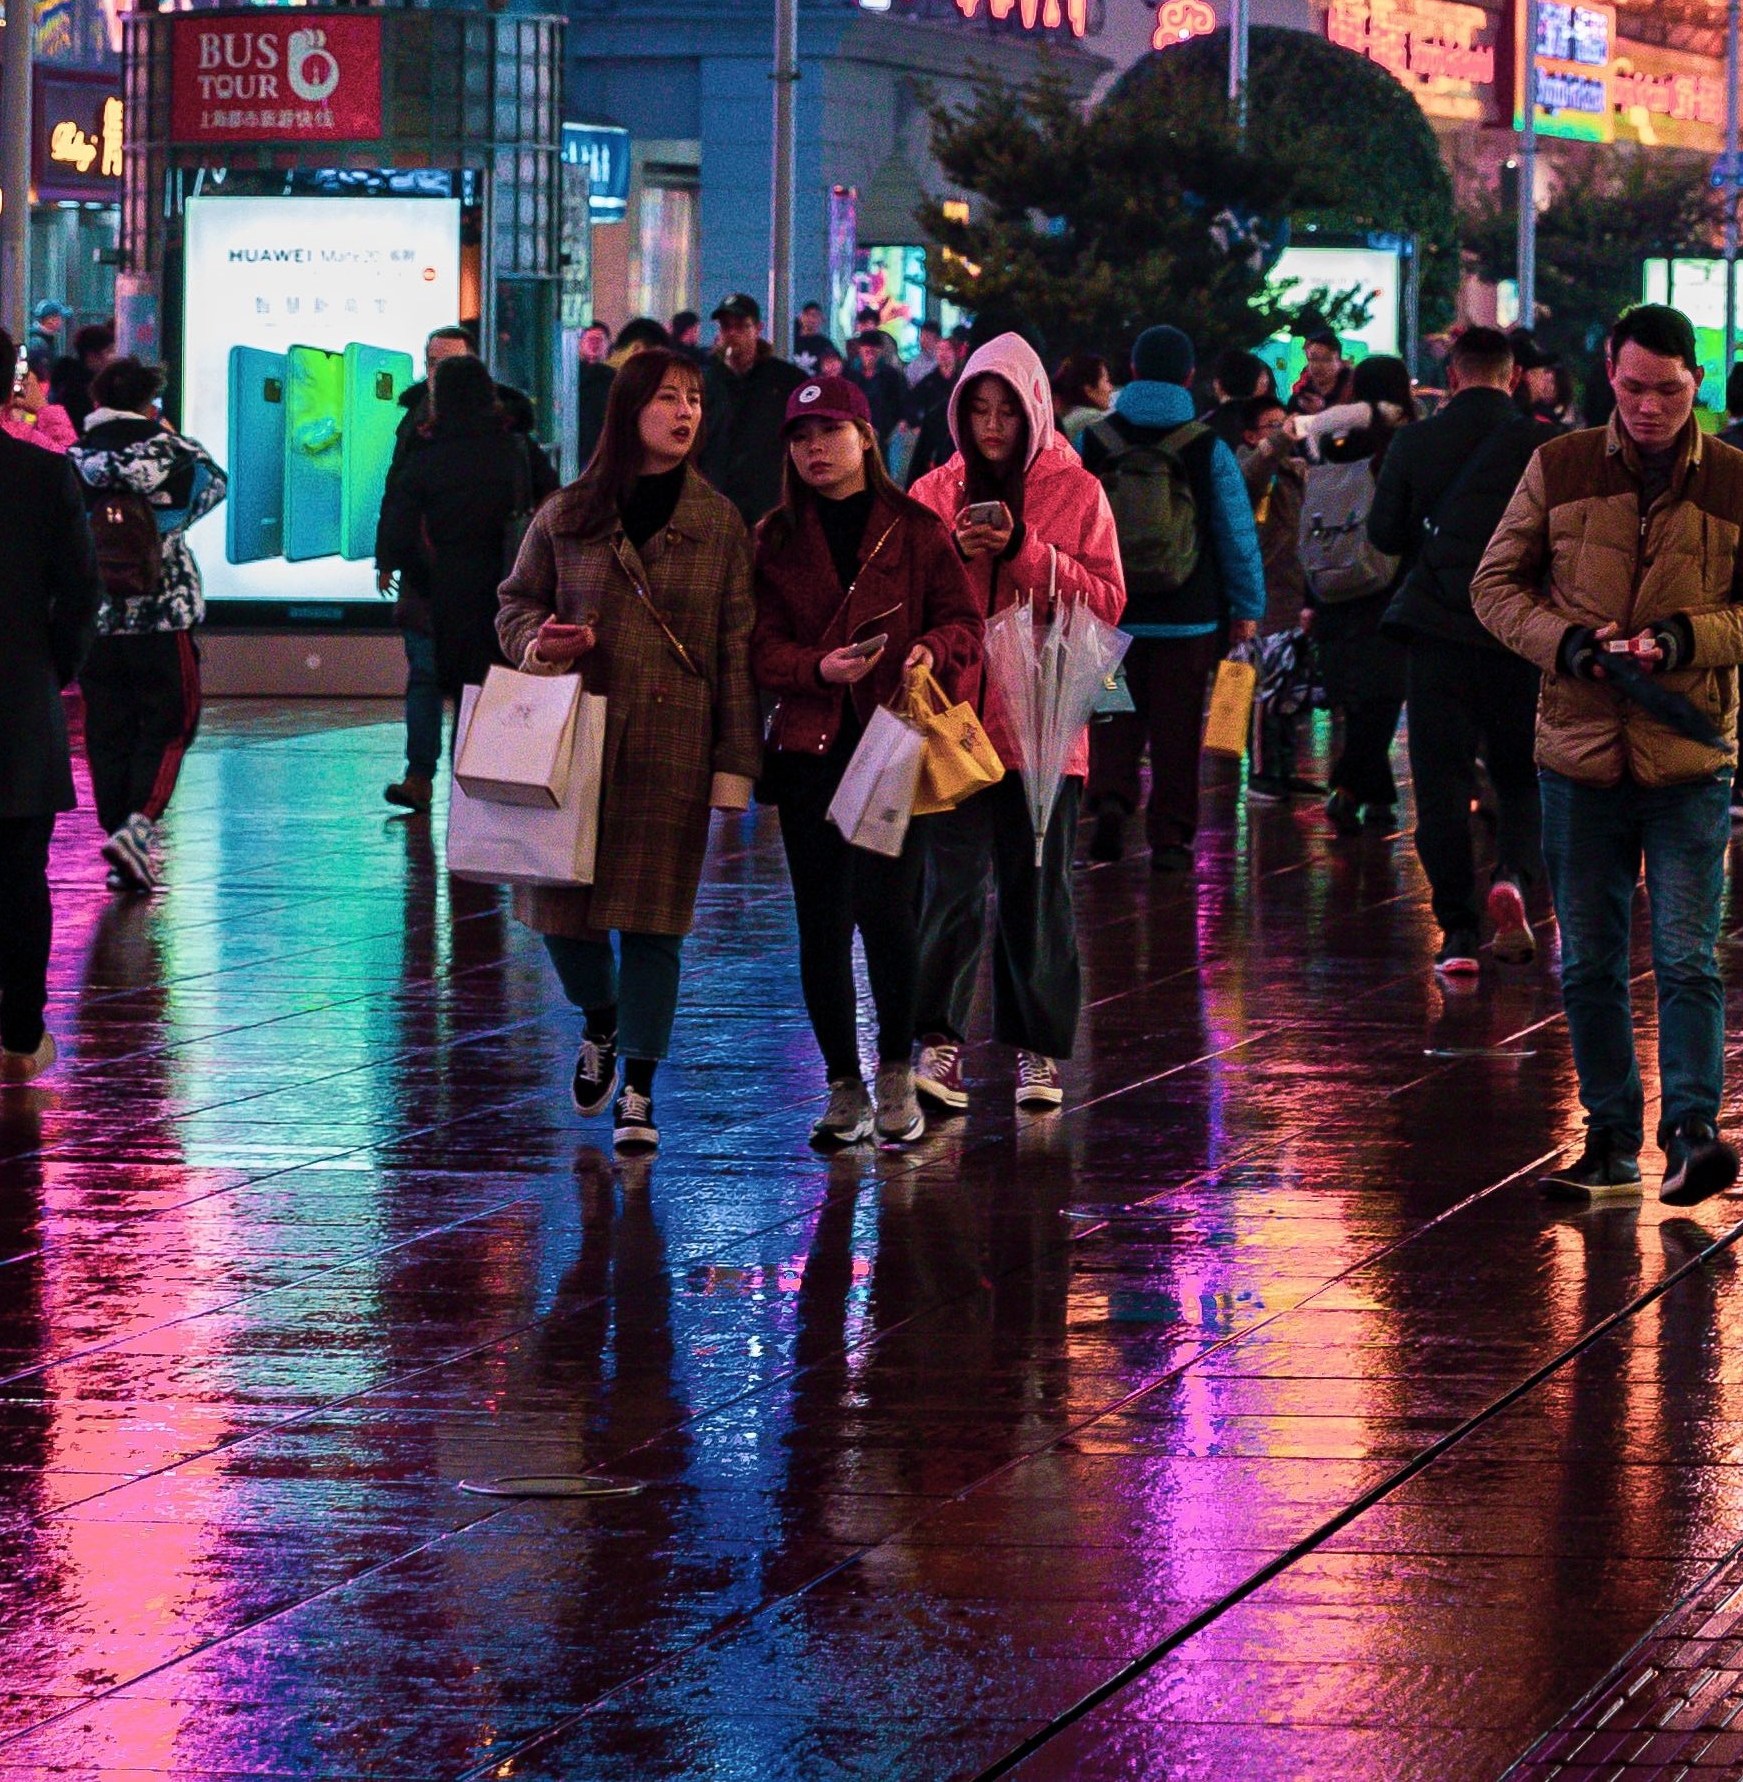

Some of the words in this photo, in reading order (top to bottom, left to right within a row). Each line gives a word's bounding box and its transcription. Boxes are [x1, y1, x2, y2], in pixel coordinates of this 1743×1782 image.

[198, 32, 280, 70] BUS
[197, 73, 280, 100] TOUR
[228, 248, 313, 263] HUAWEI
